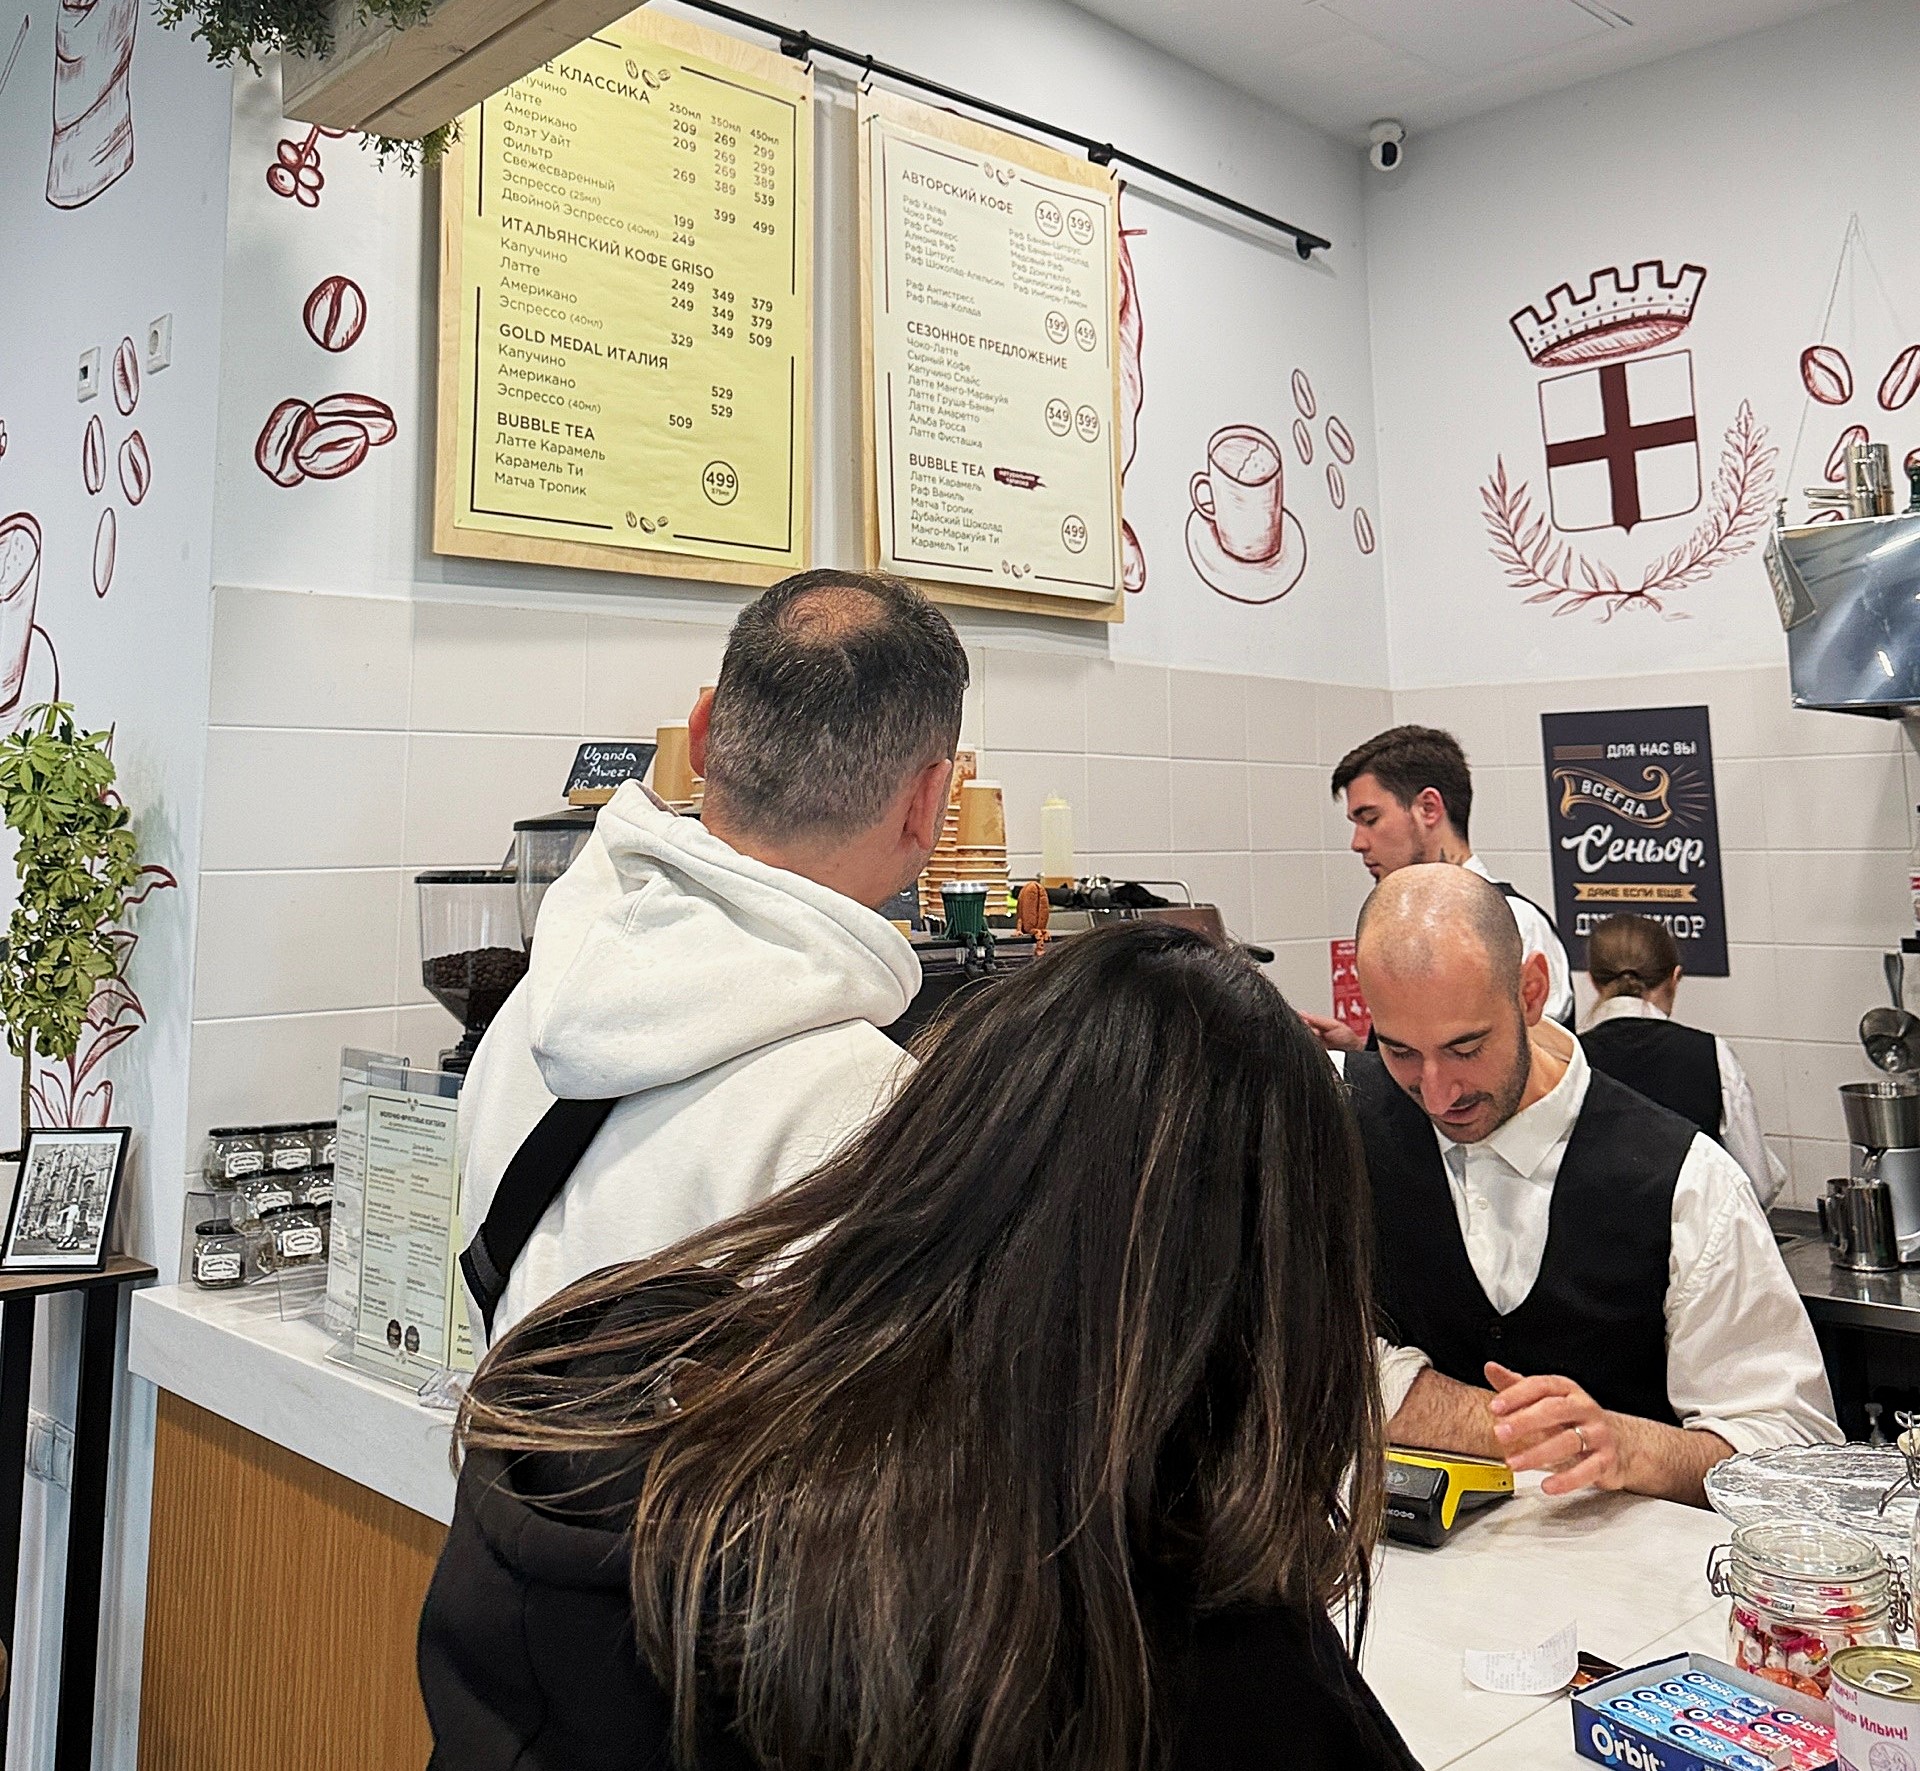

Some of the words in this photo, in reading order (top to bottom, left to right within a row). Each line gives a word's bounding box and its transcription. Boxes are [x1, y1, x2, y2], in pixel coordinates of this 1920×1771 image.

[504, 87, 542, 106] Латте
[560, 65, 650, 104] КЛАССИКА
[504, 102, 577, 132] Американо
[670, 102, 701, 120] 250мл
[711, 116, 740, 132] 350мл
[750, 129, 779, 145] 450мл
[504, 120, 537, 137] Флэт
[542, 130, 570, 148] Уайт
[673, 119, 696, 135] 209
[714, 132, 736, 148] 269
[754, 145, 774, 160] 299
[503, 137, 552, 159] Фильтр
[673, 137, 696, 152] 209
[714, 149, 736, 164] 269
[754, 162, 775, 176] 299
[503, 152, 615, 190] Свежесваренный
[503, 169, 566, 196] Эспрессо
[715, 164, 736, 179] 269
[754, 175, 774, 190] 389
[673, 169, 695, 184] 269
[715, 180, 736, 195] 389
[754, 192, 774, 206] 539
[902, 170, 977, 202] АВТОРСКИЙ
[981, 195, 1013, 215] КОФЕ
[502, 188, 560, 211] Двойной
[563, 204, 623, 228] Эспрессо
[627, 222, 658, 239] (40мл)
[674, 215, 694, 229] 199
[714, 209, 735, 224] 399
[753, 221, 774, 235] 499
[1039, 208, 1059, 223] 349
[1071, 217, 1091, 232] 399
[501, 238, 567, 263] Капучино
[502, 216, 619, 256] ИТАЛЬЯНСКИЙ
[625, 247, 667, 268] КОФЕ
[672, 259, 714, 279] GRISO
[672, 232, 695, 246] 249
[501, 257, 540, 276] Латте
[501, 277, 577, 303] Американо
[672, 279, 694, 293] 249
[712, 288, 734, 303] 349
[752, 298, 772, 312] 379
[500, 295, 566, 320] Эспрессо
[571, 314, 603, 329] (40мл)
[672, 297, 694, 311] 249
[712, 306, 734, 321] 349
[751, 315, 772, 330] 379
[712, 324, 734, 338] 349
[749, 333, 772, 347] 509
[1049, 318, 1067, 332] 399
[500, 324, 545, 343] GOLD
[551, 334, 603, 356] MEDAL
[608, 346, 668, 369] ИТАЛИЯ
[671, 333, 693, 347] 329
[907, 321, 975, 347] СЕЗОННОЕ
[980, 338, 1067, 369] ПРЕДЛОЖЕНИЕ
[498, 344, 566, 368] Капучино
[498, 364, 576, 388] Американо
[908, 363, 951, 380] Капучино
[908, 375, 934, 388] Латте
[498, 383, 564, 406] Эспрессо
[568, 400, 601, 413] (40мл)
[712, 386, 733, 400] 529
[908, 388, 934, 400] Латте
[712, 404, 732, 418] 529
[908, 401, 935, 414] Латте
[1050, 407, 1069, 423] 349
[1078, 414, 1097, 429] 399
[498, 412, 560, 434] BUBBLE
[565, 424, 595, 440] TEA
[669, 415, 692, 428] 509
[496, 432, 536, 449] Латте
[541, 439, 605, 460] Карамель
[910, 427, 935, 439] Латте
[938, 432, 982, 448] Фисташка
[496, 452, 562, 473] Карамель
[568, 463, 583, 476] Ти
[910, 454, 958, 473] BUBBLE
[962, 463, 985, 478] TEA
[495, 472, 535, 488] Матча
[539, 478, 587, 496] Тропик
[706, 472, 735, 488] 499
[911, 471, 936, 484] Латте
[939, 477, 981, 491] Карамель
[911, 484, 929, 496] Раф
[911, 497, 938, 510] Матча
[942, 502, 974, 515] Тропик
[911, 510, 960, 524] Дубайский
[963, 517, 1002, 533] Шоколад
[912, 524, 986, 542] Манго-Маракуйя
[989, 534, 999, 543] Ти
[1065, 524, 1084, 538] 499
[912, 537, 955, 551] Карамель
[958, 543, 969, 552] Ти
[584, 746, 636, 766] Uganda
[1607, 744, 1637, 759] ДЛЯ
[1640, 742, 1670, 756] НАС
[1674, 741, 1697, 755] ВЫ
[588, 766, 633, 777] Mwezi
[1581, 780, 1648, 818] ВСЕГДА
[1561, 824, 1706, 874] Сеньор,
[1587, 888, 1618, 897] ДАЖЕ
[1623, 888, 1653, 898] ЕСЛИ
[1665, 1683, 1710, 1708] Orbit
[1688, 1674, 1732, 1696] Orbit
[1615, 1701, 1661, 1724] Orbit
[1689, 1709, 1740, 1735] Orbit
[1777, 1712, 1829, 1737] Orbit
[1675, 1727, 1726, 1752] Orbit
[1754, 1723, 1806, 1749] Orbit
[1860, 1715, 1908, 1740] Ильич!
[1592, 1724, 1660, 1771] Orbit
